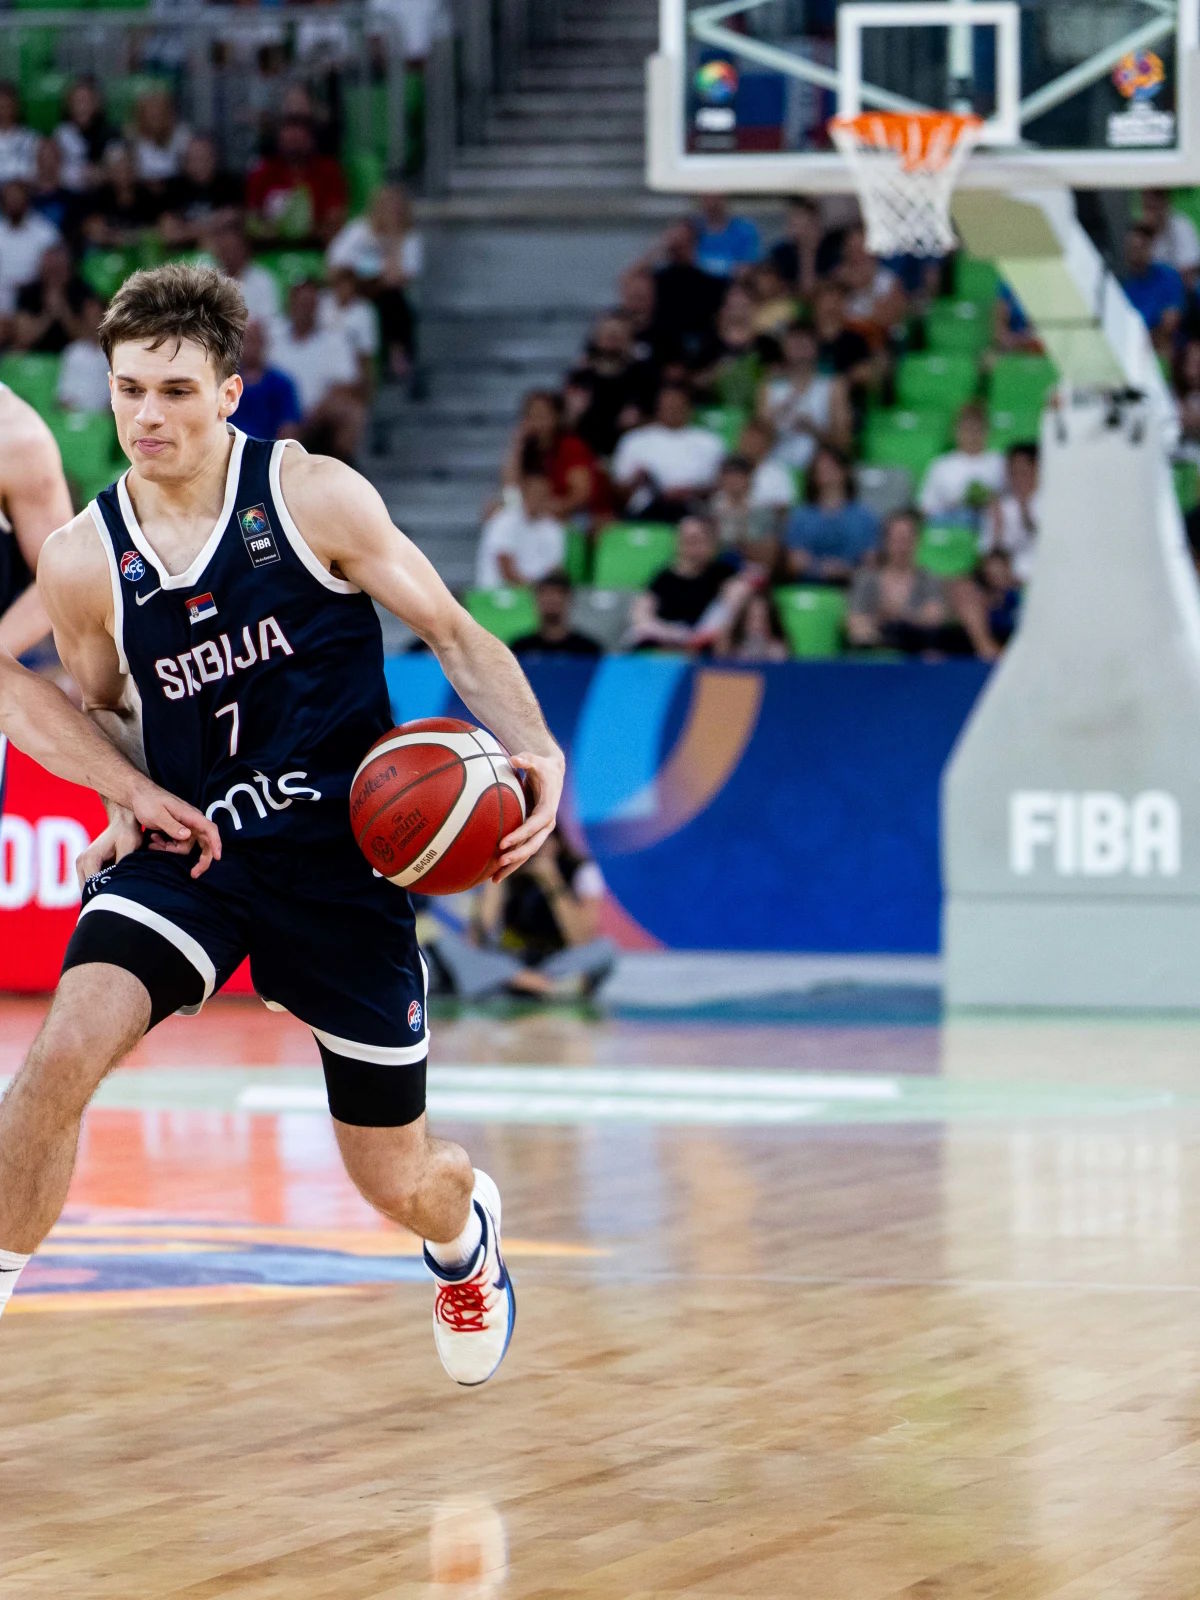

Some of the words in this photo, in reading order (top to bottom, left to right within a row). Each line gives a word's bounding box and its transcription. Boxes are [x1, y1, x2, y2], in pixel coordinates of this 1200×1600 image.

[250, 537, 271, 552] FIBA
[214, 701, 240, 757] 7
[205, 769, 322, 831] mts
[412, 849, 438, 874] BG4500
[1010, 791, 1181, 877] FIBA
